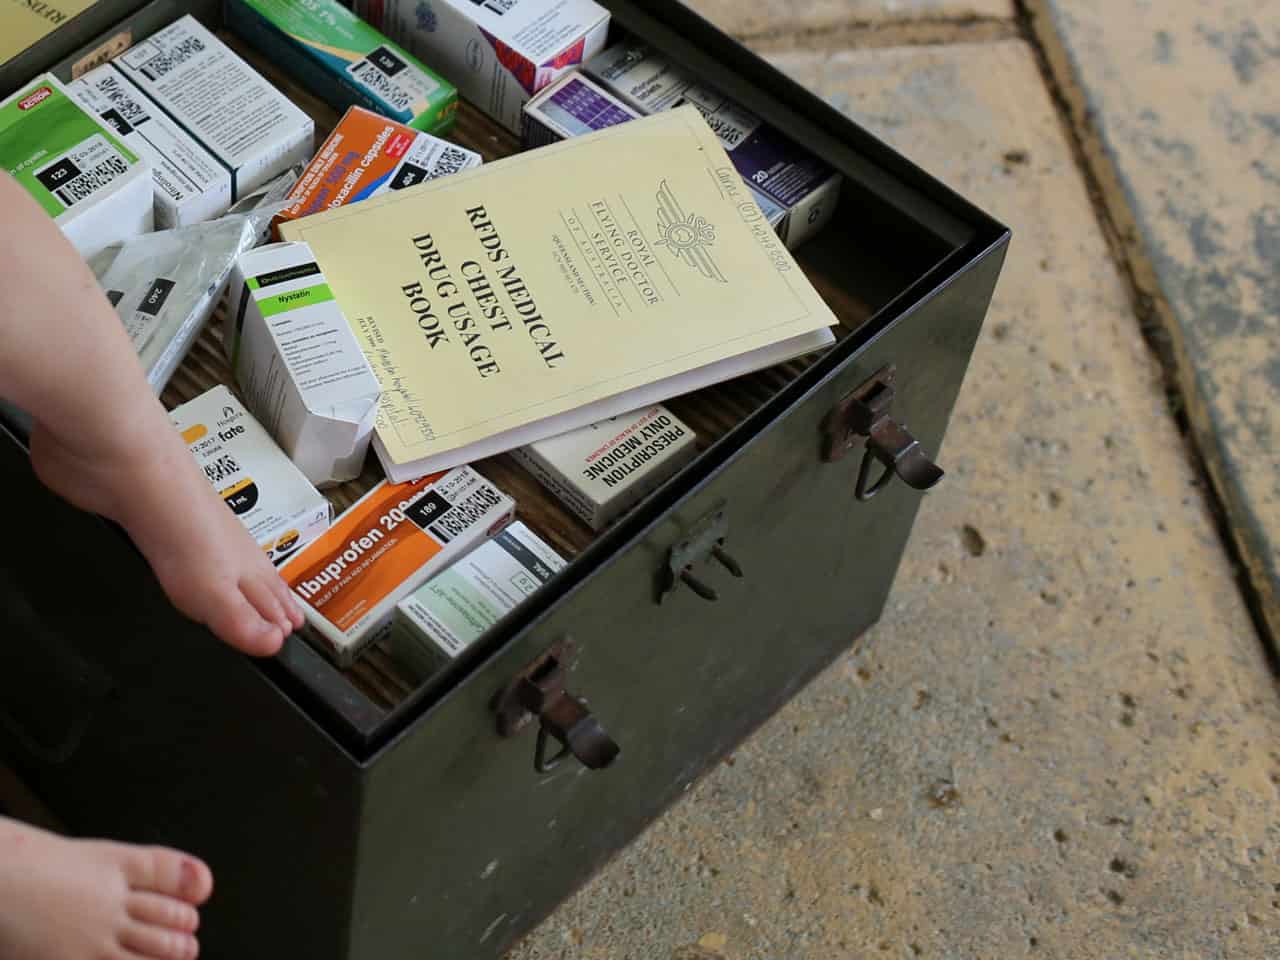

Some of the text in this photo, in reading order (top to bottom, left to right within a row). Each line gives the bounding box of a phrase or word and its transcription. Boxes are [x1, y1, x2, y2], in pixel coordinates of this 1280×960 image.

[51, 168, 68, 181] 123
[361, 126, 395, 167] capsules
[581, 239, 623, 307] AUSTRALIA
[590, 232, 628, 284] SERVICE
[592, 200, 659, 305] FLYING DOCTOR
[627, 229, 656, 267] ROYAL
[278, 290, 311, 304] Nystatin
[401, 280, 450, 350] BOOK
[412, 232, 501, 378] DRUG USAGE
[460, 260, 513, 332] CHEST
[465, 204, 565, 369] RFDS MEDICAL
[603, 425, 685, 487] PRESCRIPTION
[640, 415, 671, 440] ONLY
[583, 435, 643, 480] MEDICINE
[420, 502, 436, 516] 189
[296, 527, 384, 599] Ibuprofen
